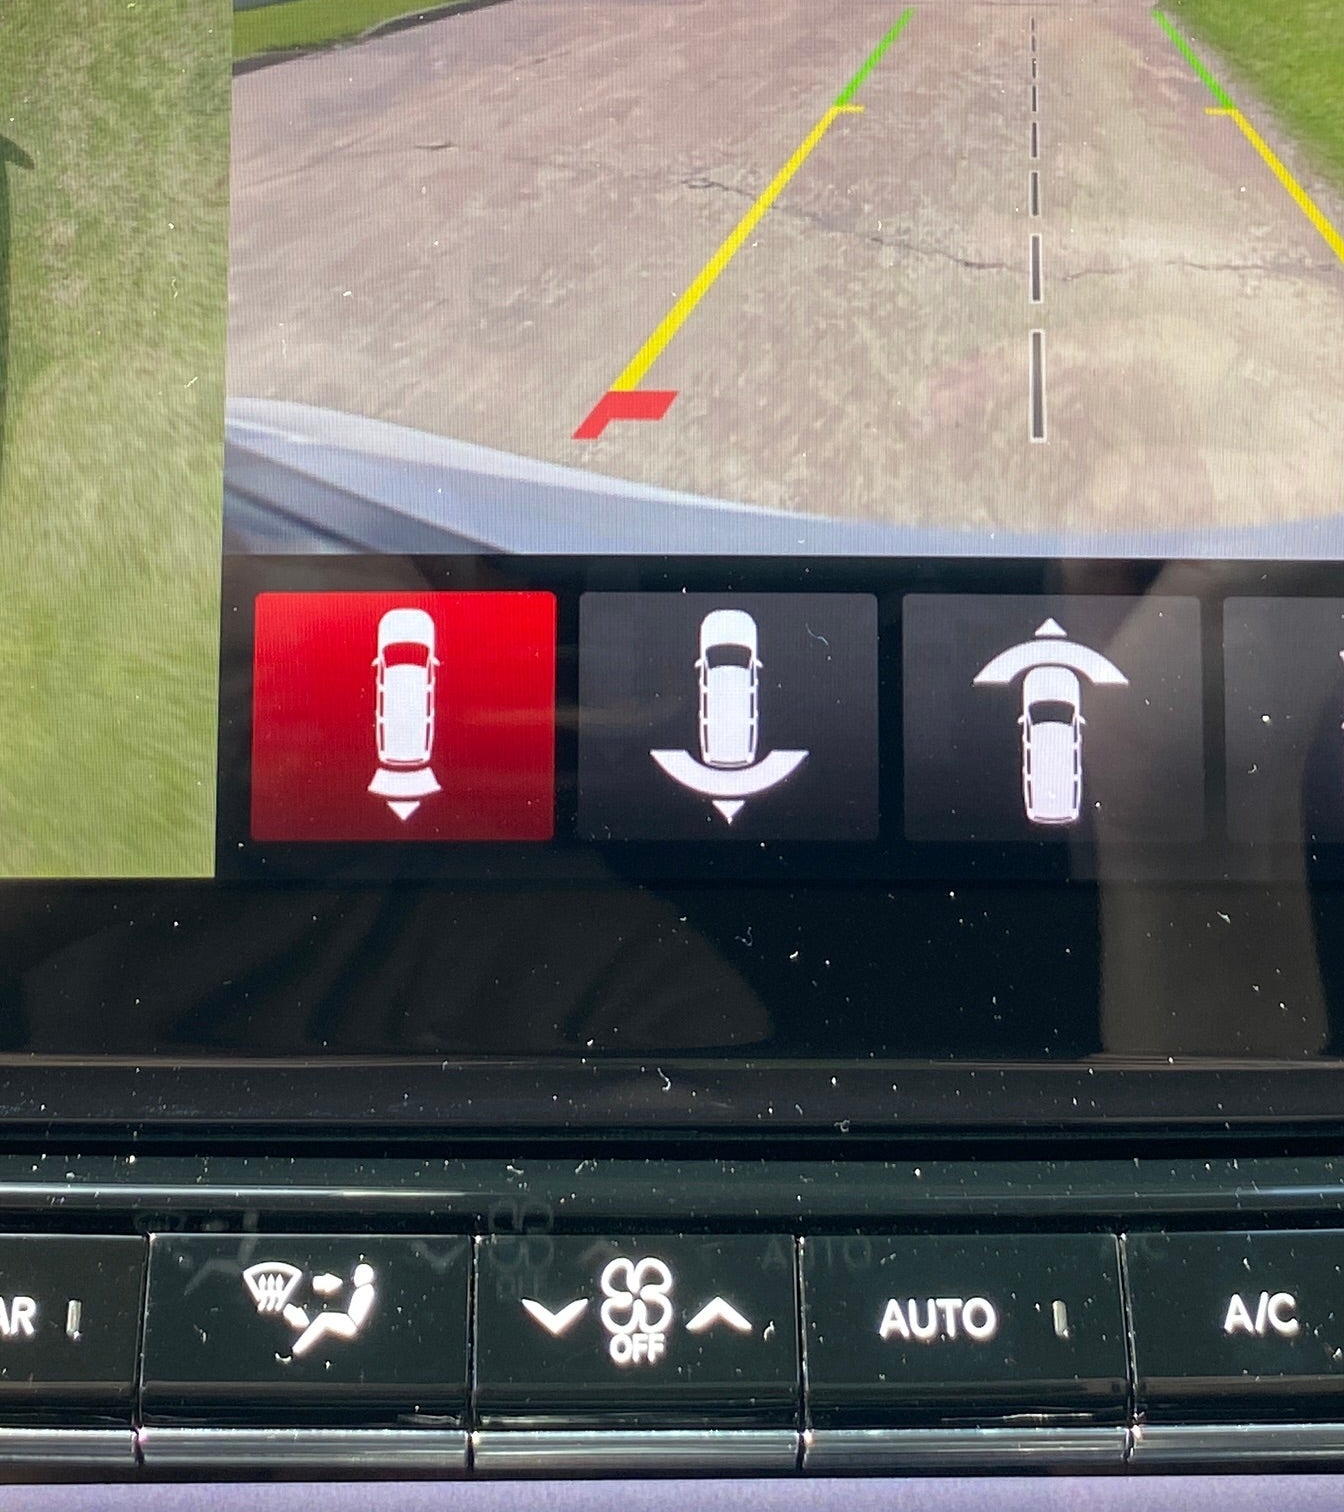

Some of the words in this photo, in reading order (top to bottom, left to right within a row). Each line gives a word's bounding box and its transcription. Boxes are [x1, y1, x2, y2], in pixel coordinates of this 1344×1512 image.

[879, 1297, 997, 1343] AUTO
[1224, 1292, 1299, 1335] A/C
[609, 1332, 666, 1366] OFF
